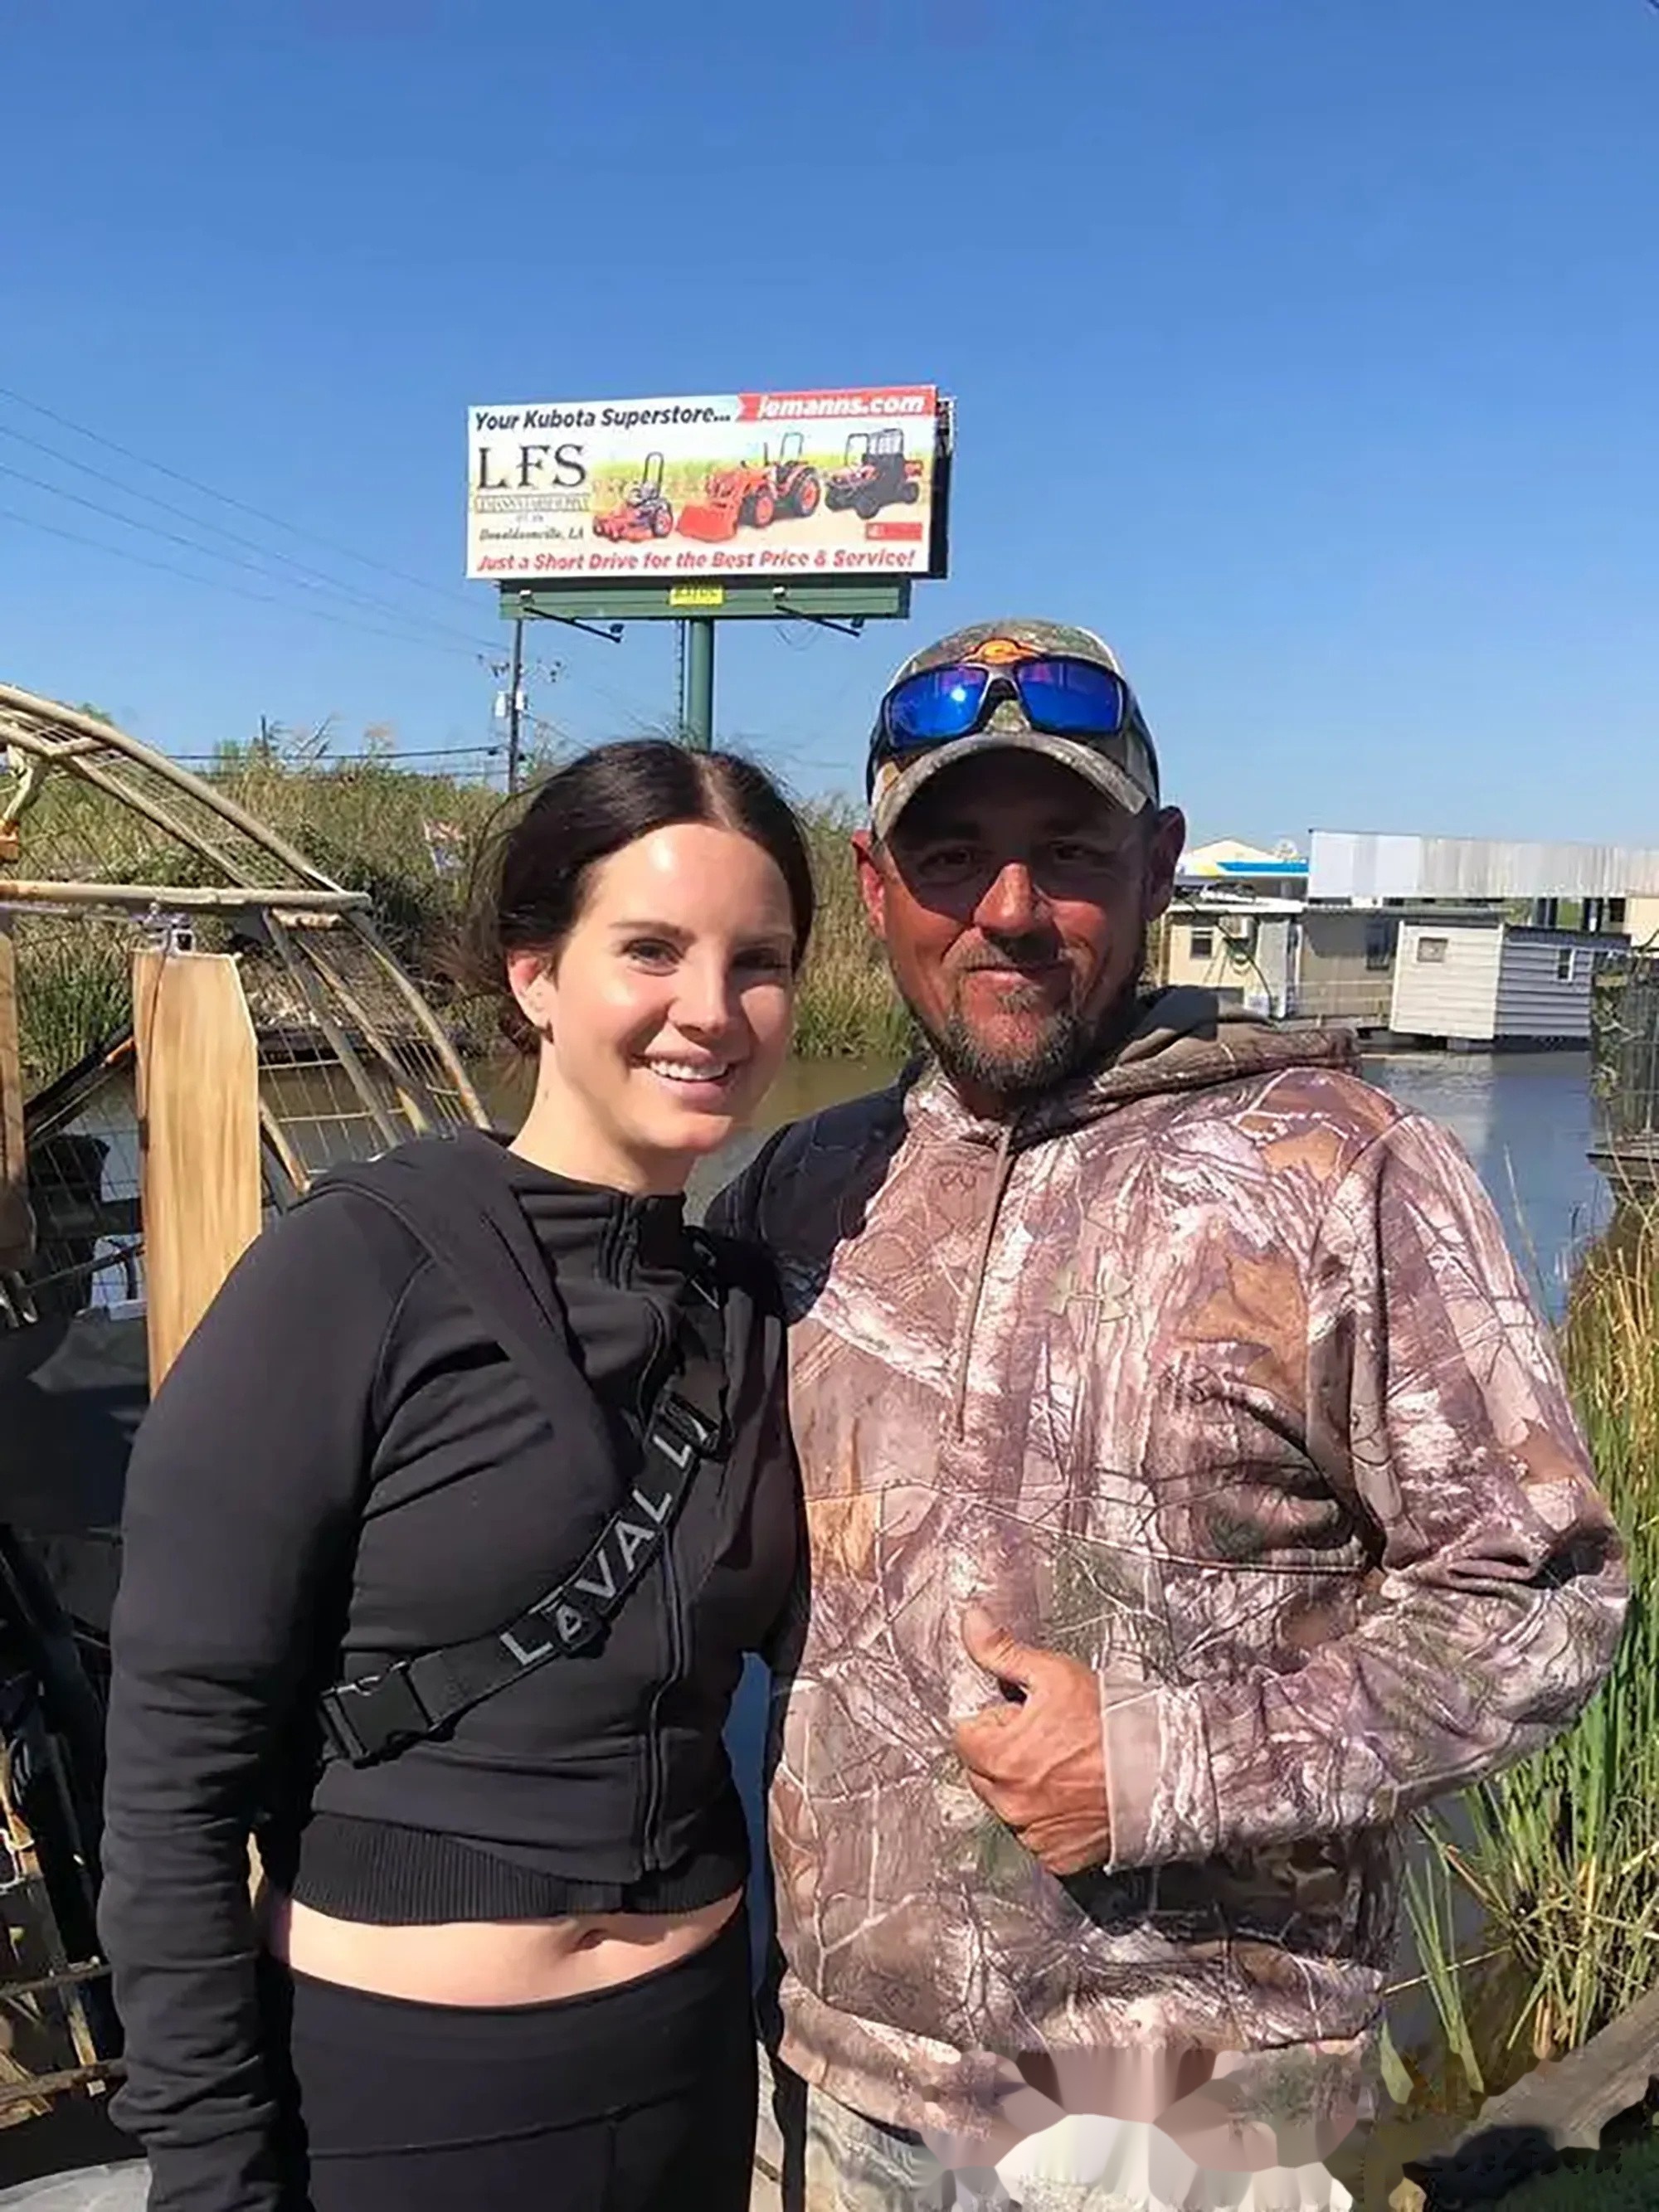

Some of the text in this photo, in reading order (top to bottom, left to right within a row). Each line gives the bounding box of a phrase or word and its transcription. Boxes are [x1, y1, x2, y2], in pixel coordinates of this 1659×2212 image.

[759, 395, 925, 417] lemanns.com
[474, 406, 731, 431] Your Kubota Superstore...
[477, 443, 587, 490] LFS
[476, 547, 917, 571] Just a Short Drive for the Best Price & Service!
